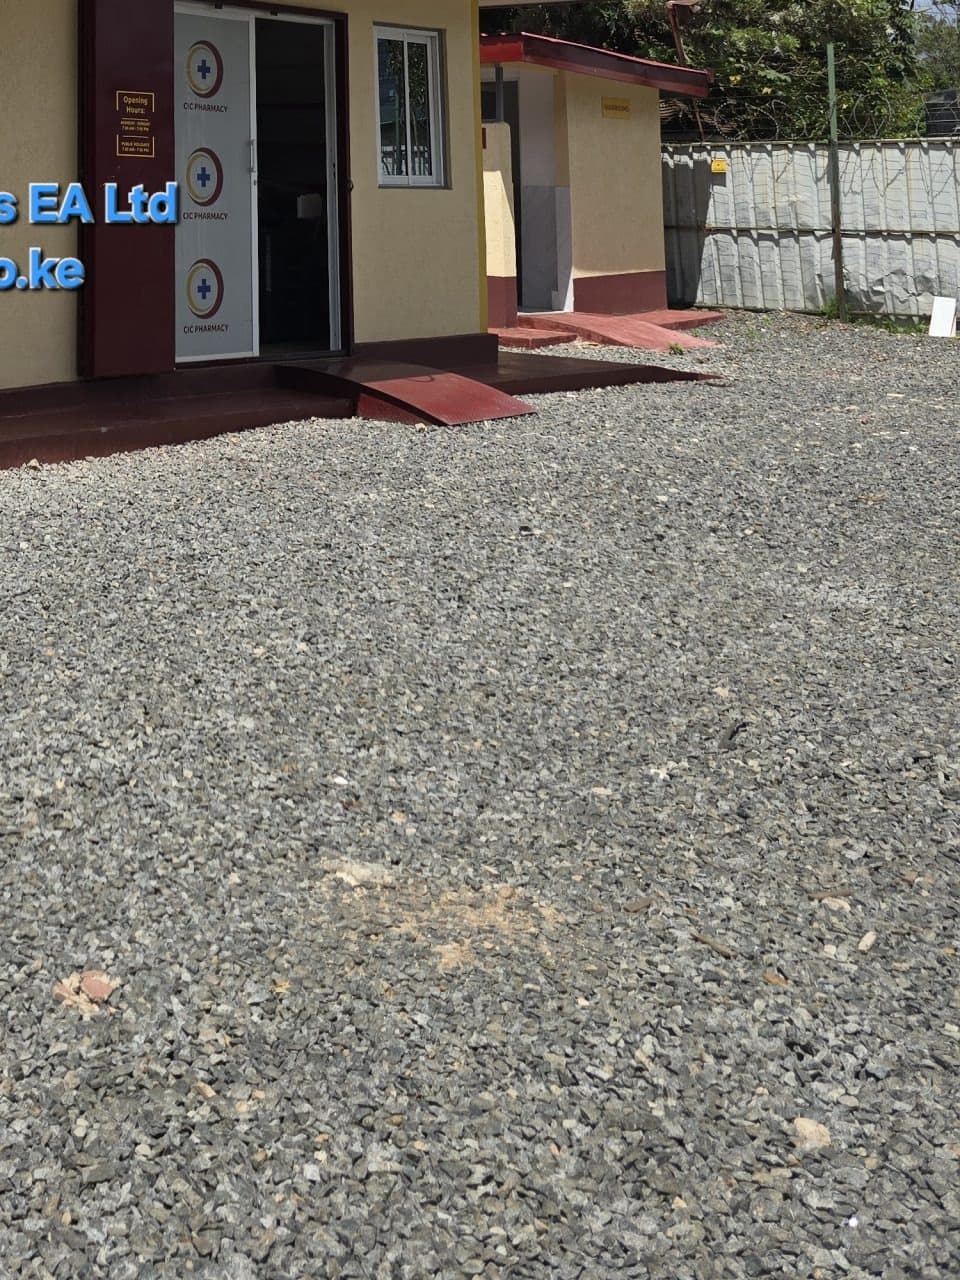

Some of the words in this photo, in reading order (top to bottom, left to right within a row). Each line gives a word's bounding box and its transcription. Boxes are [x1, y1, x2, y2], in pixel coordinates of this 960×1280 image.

[123, 96, 148, 106] Opening
[183, 102, 193, 111] CIC
[194, 103, 228, 113] PHARMACY
[182, 211, 193, 220] CIC
[194, 212, 228, 221] PHARMACY
[183, 325, 193, 334] CIC
[194, 323, 228, 333] PHARMACY
